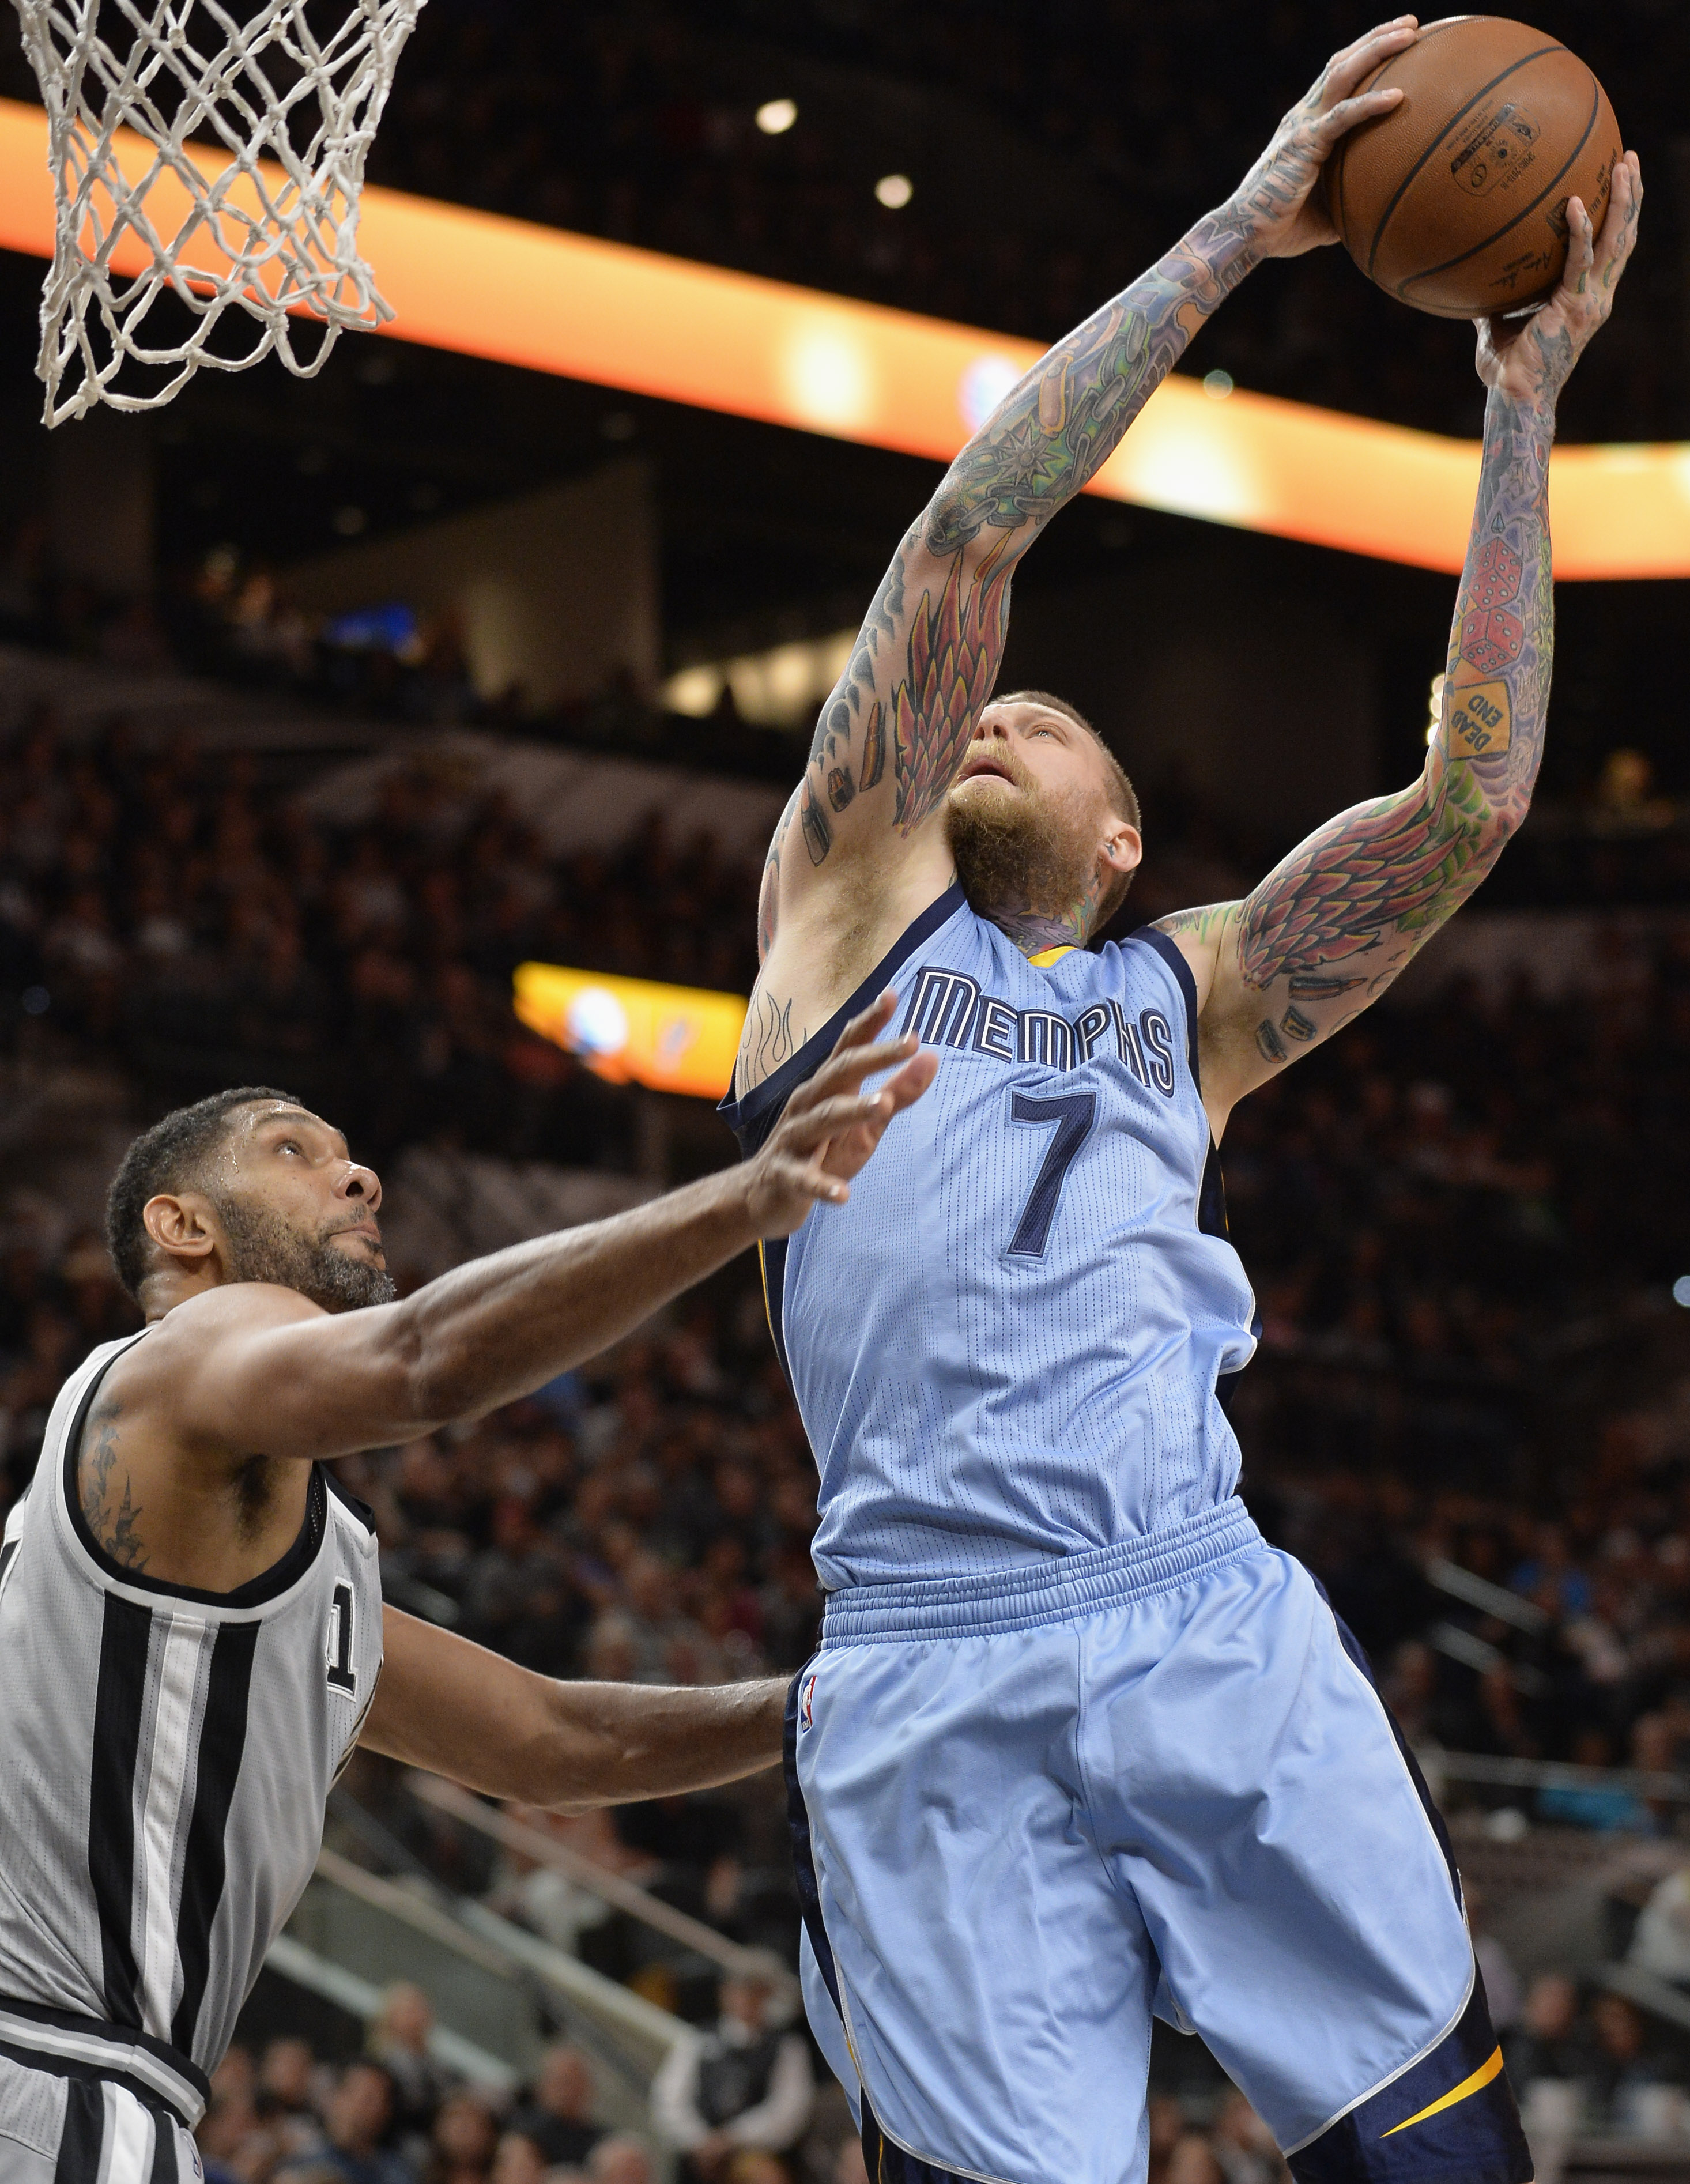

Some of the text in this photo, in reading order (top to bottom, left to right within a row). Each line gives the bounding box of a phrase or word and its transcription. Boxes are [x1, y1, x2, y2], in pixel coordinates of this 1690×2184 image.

[1451, 710, 1491, 751] DEAD
[1468, 695, 1503, 727] END
[1004, 1086, 1100, 1262] 7
